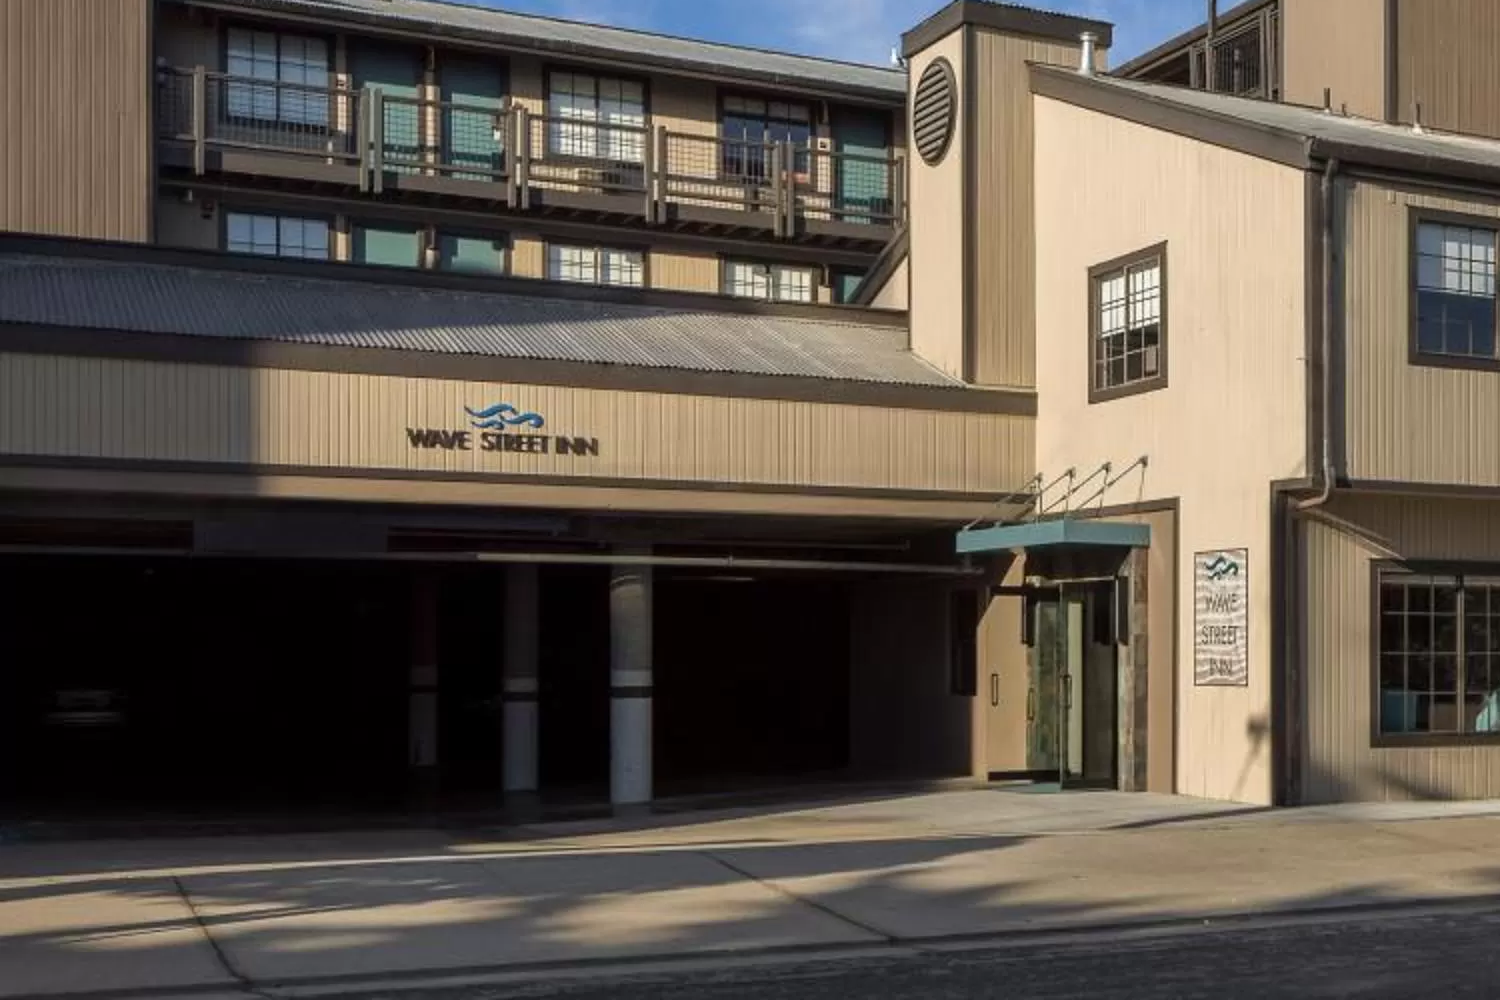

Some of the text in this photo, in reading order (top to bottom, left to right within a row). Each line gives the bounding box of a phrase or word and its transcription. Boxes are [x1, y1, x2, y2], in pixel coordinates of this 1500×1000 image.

[406, 428, 599, 456] WAVE STREET INN
[1205, 593, 1239, 613] WAVE
[1201, 625, 1240, 645] STREET
[1209, 657, 1233, 676] INN
